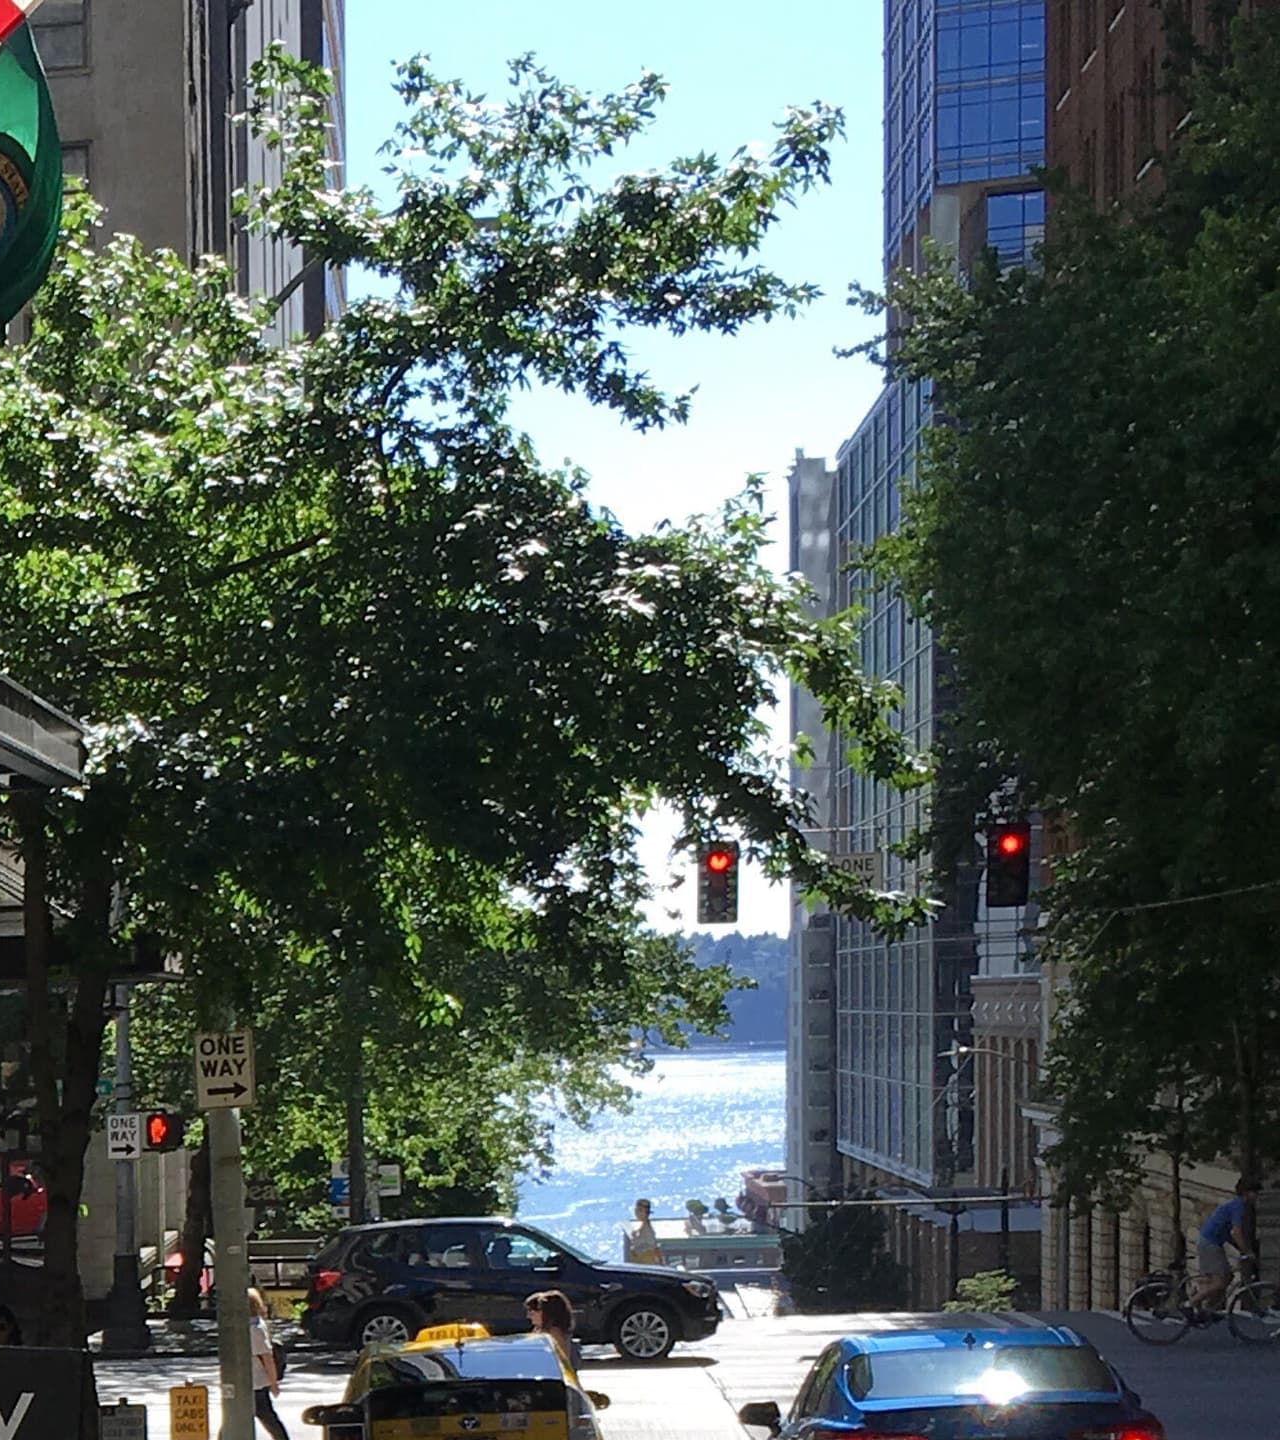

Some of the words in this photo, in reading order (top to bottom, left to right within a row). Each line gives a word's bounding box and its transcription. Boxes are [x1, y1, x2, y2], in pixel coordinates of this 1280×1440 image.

[841, 857, 874, 872] ONE
[199, 1036, 245, 1056] ONE
[200, 1058, 247, 1078] WAY
[110, 1117, 137, 1129] ONE
[110, 1130, 137, 1142] WAY
[175, 1394, 204, 1406] TAXI
[175, 1408, 205, 1420] CABS
[175, 1422, 205, 1433] ONLY
